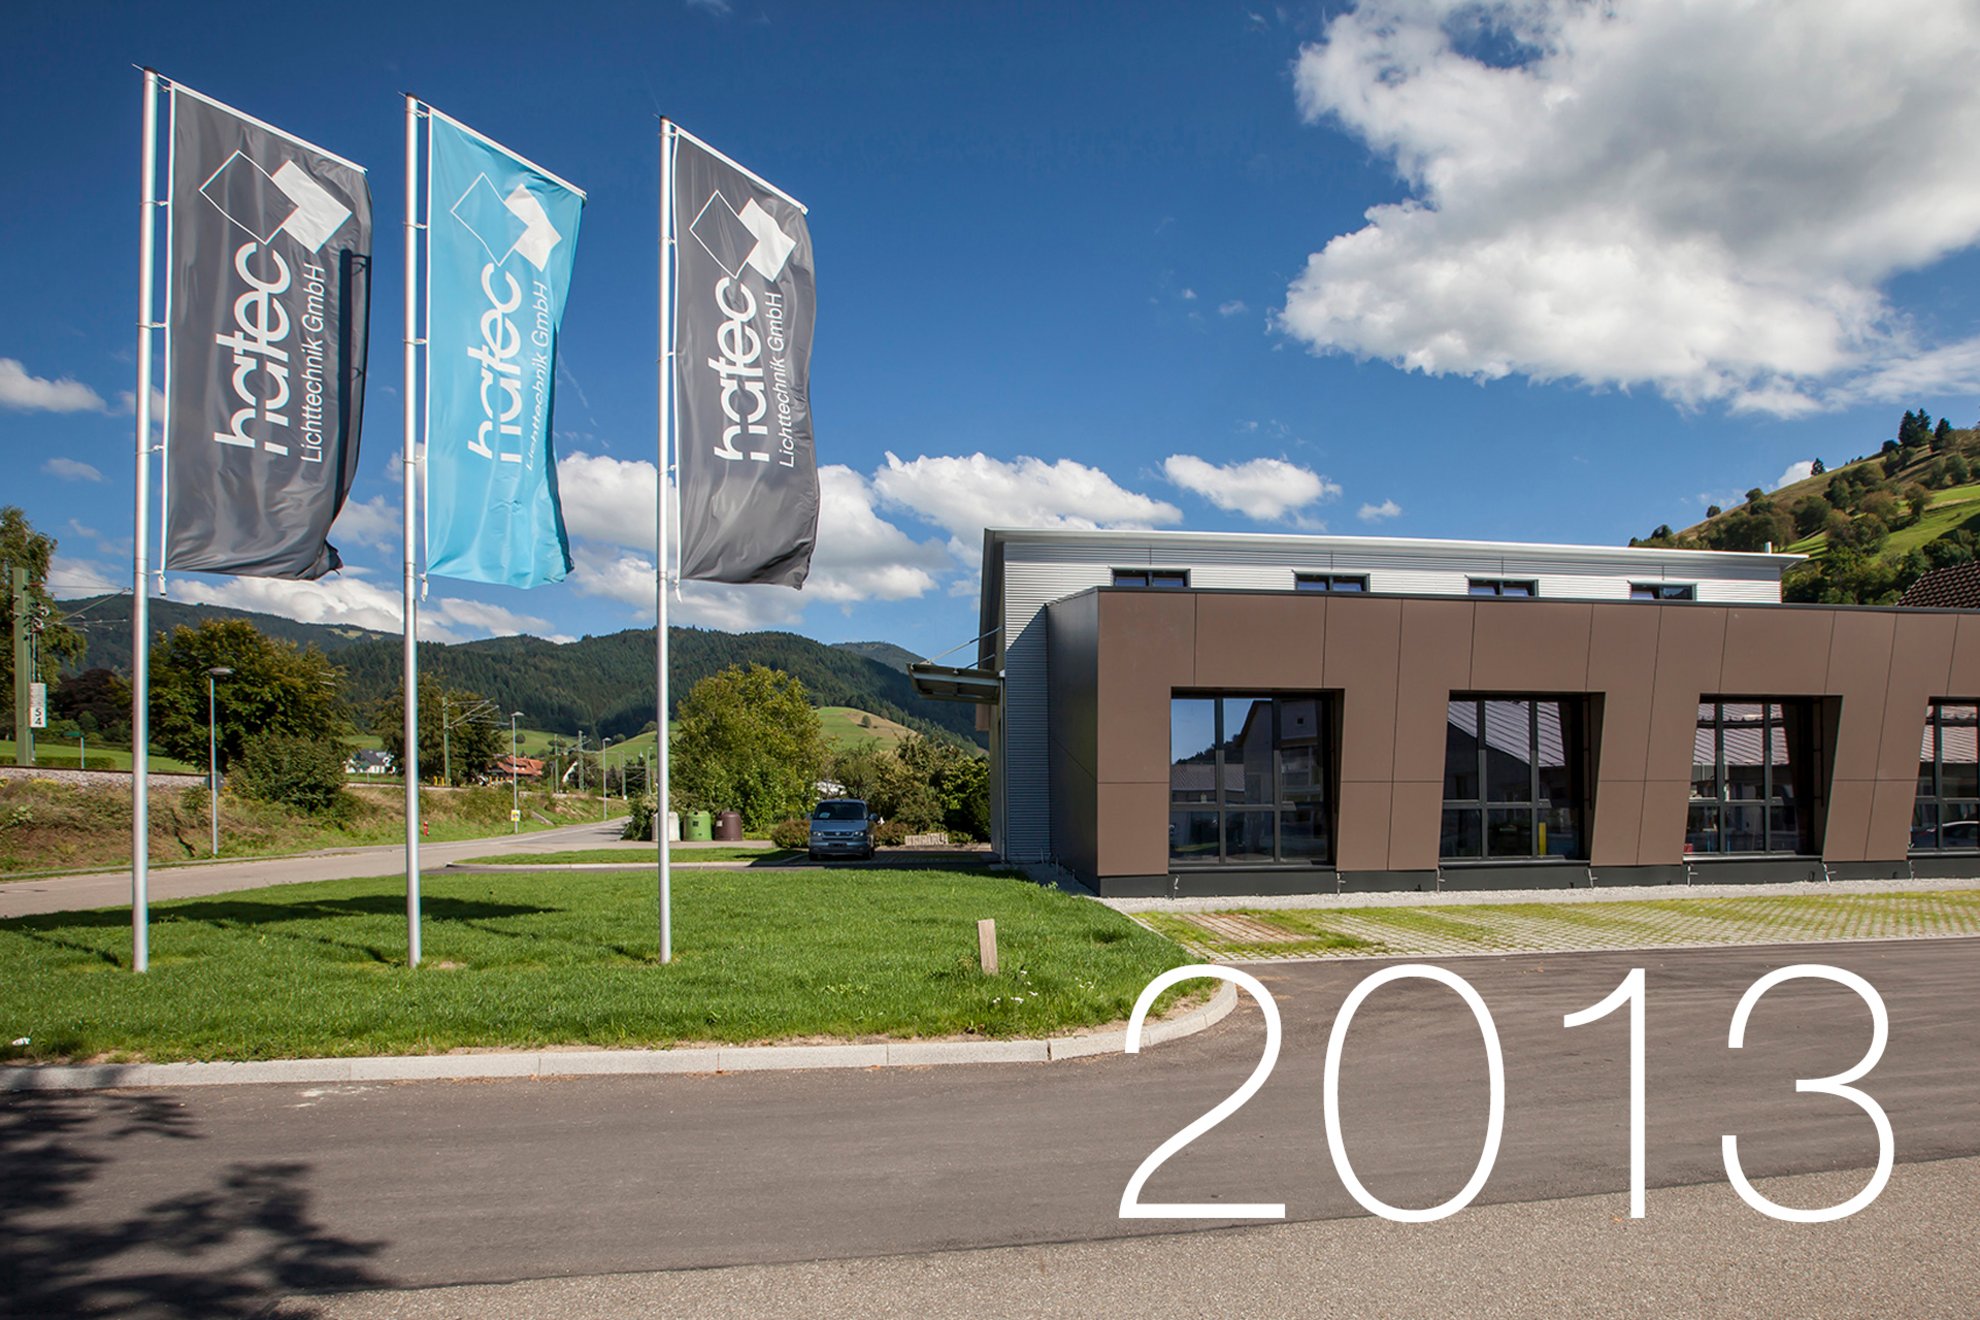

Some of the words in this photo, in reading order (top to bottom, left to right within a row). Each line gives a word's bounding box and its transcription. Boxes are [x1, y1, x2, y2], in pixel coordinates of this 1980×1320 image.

[213, 241, 292, 456] hatec
[301, 262, 326, 333] GmbH
[531, 281, 549, 347] GmbH
[767, 291, 785, 352] GmbH
[300, 339, 324, 464] Lichttechnik
[466, 262, 523, 464] hatec
[707, 276, 770, 463] hatec
[770, 356, 795, 468] Lichttechnik
